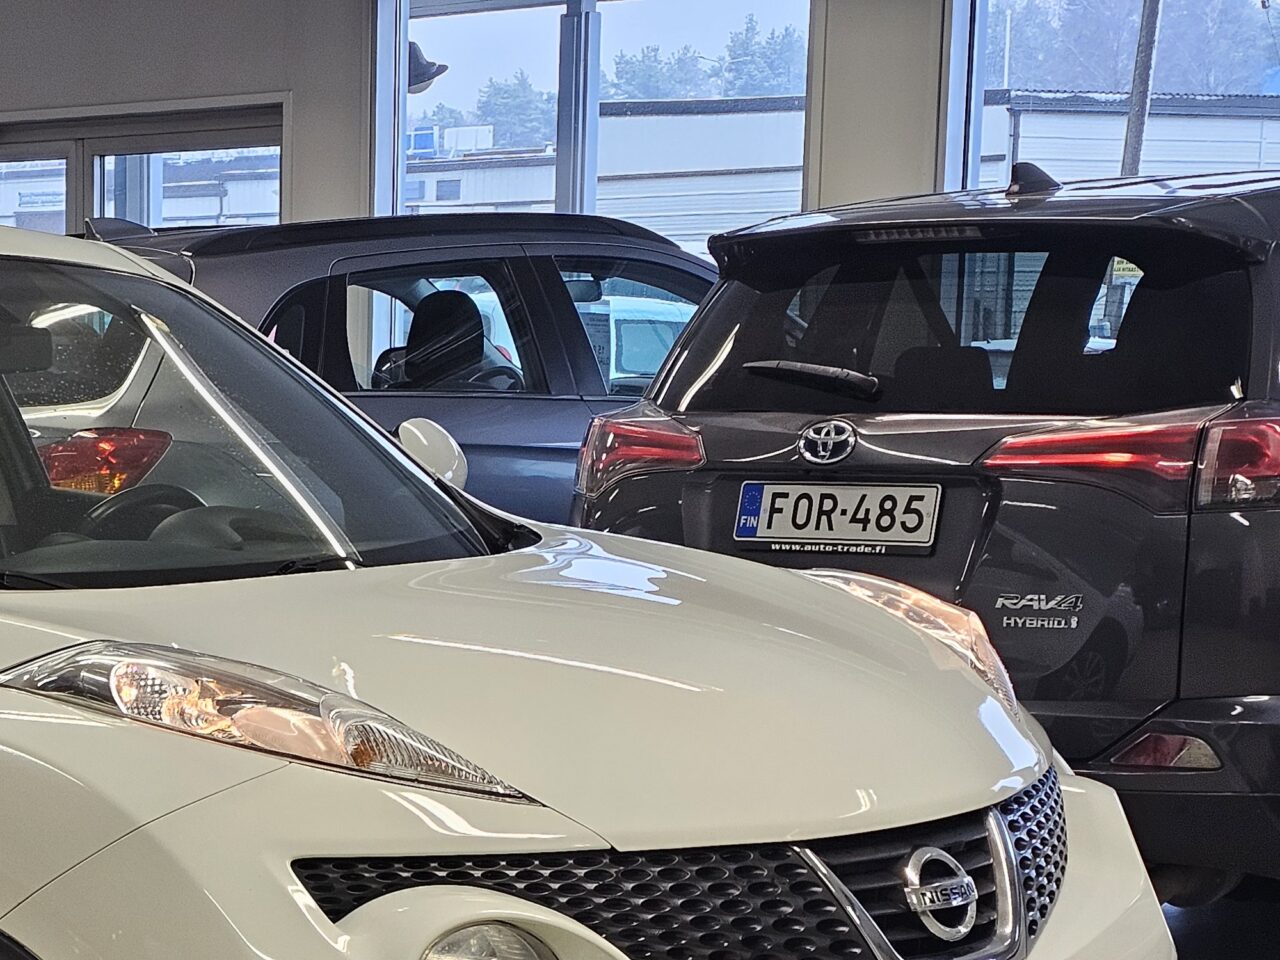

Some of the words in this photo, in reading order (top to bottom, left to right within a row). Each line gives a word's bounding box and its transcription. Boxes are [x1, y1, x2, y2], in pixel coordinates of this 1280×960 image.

[739, 515, 758, 528] FIN
[766, 491, 926, 534] FOR-485
[771, 543, 887, 554] www.auto-trade.fi
[995, 593, 1083, 611] RAV4
[1002, 616, 1066, 628] HYBRID
[920, 881, 975, 906] NISSAN
